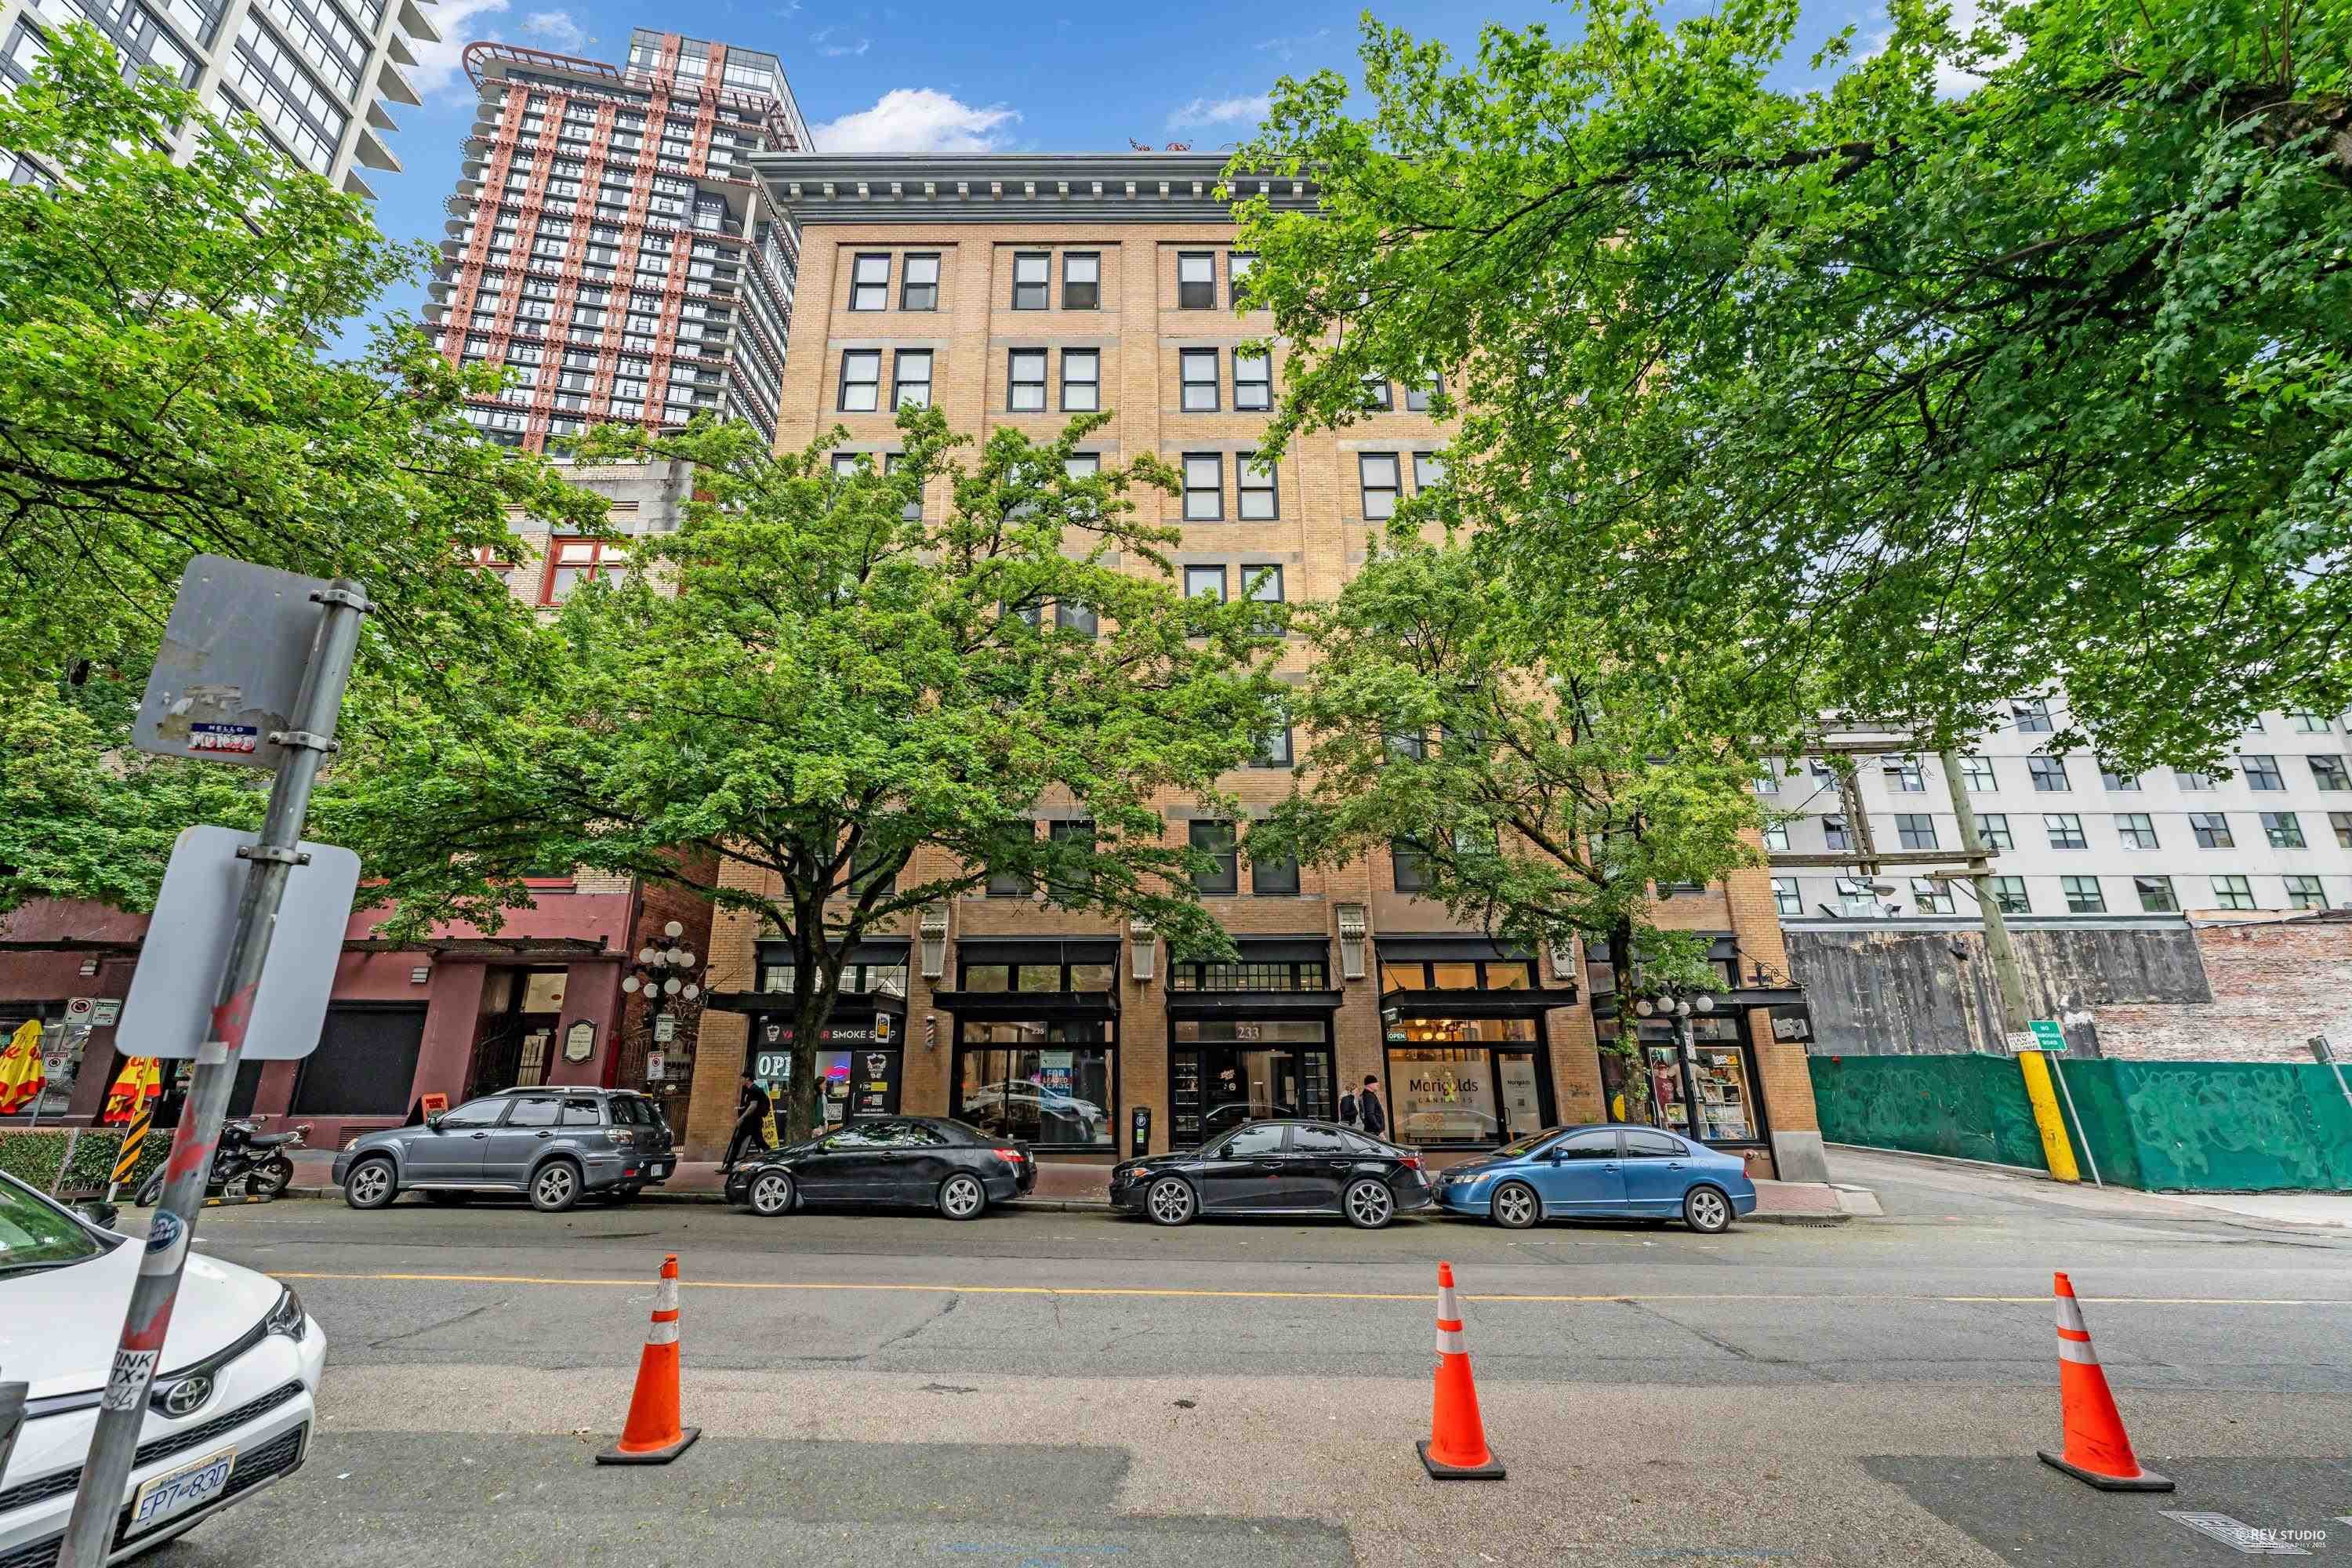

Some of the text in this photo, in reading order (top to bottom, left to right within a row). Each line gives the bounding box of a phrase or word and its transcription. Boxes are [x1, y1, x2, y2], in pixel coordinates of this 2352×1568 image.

[208, 724, 245, 733] HELLO
[833, 1030, 866, 1039] SMOKE
[869, 1030, 896, 1039] SP
[1236, 1027, 1260, 1040] 233
[1047, 1069, 1065, 1077] FOR
[1409, 1078, 1479, 1096] Marigolds
